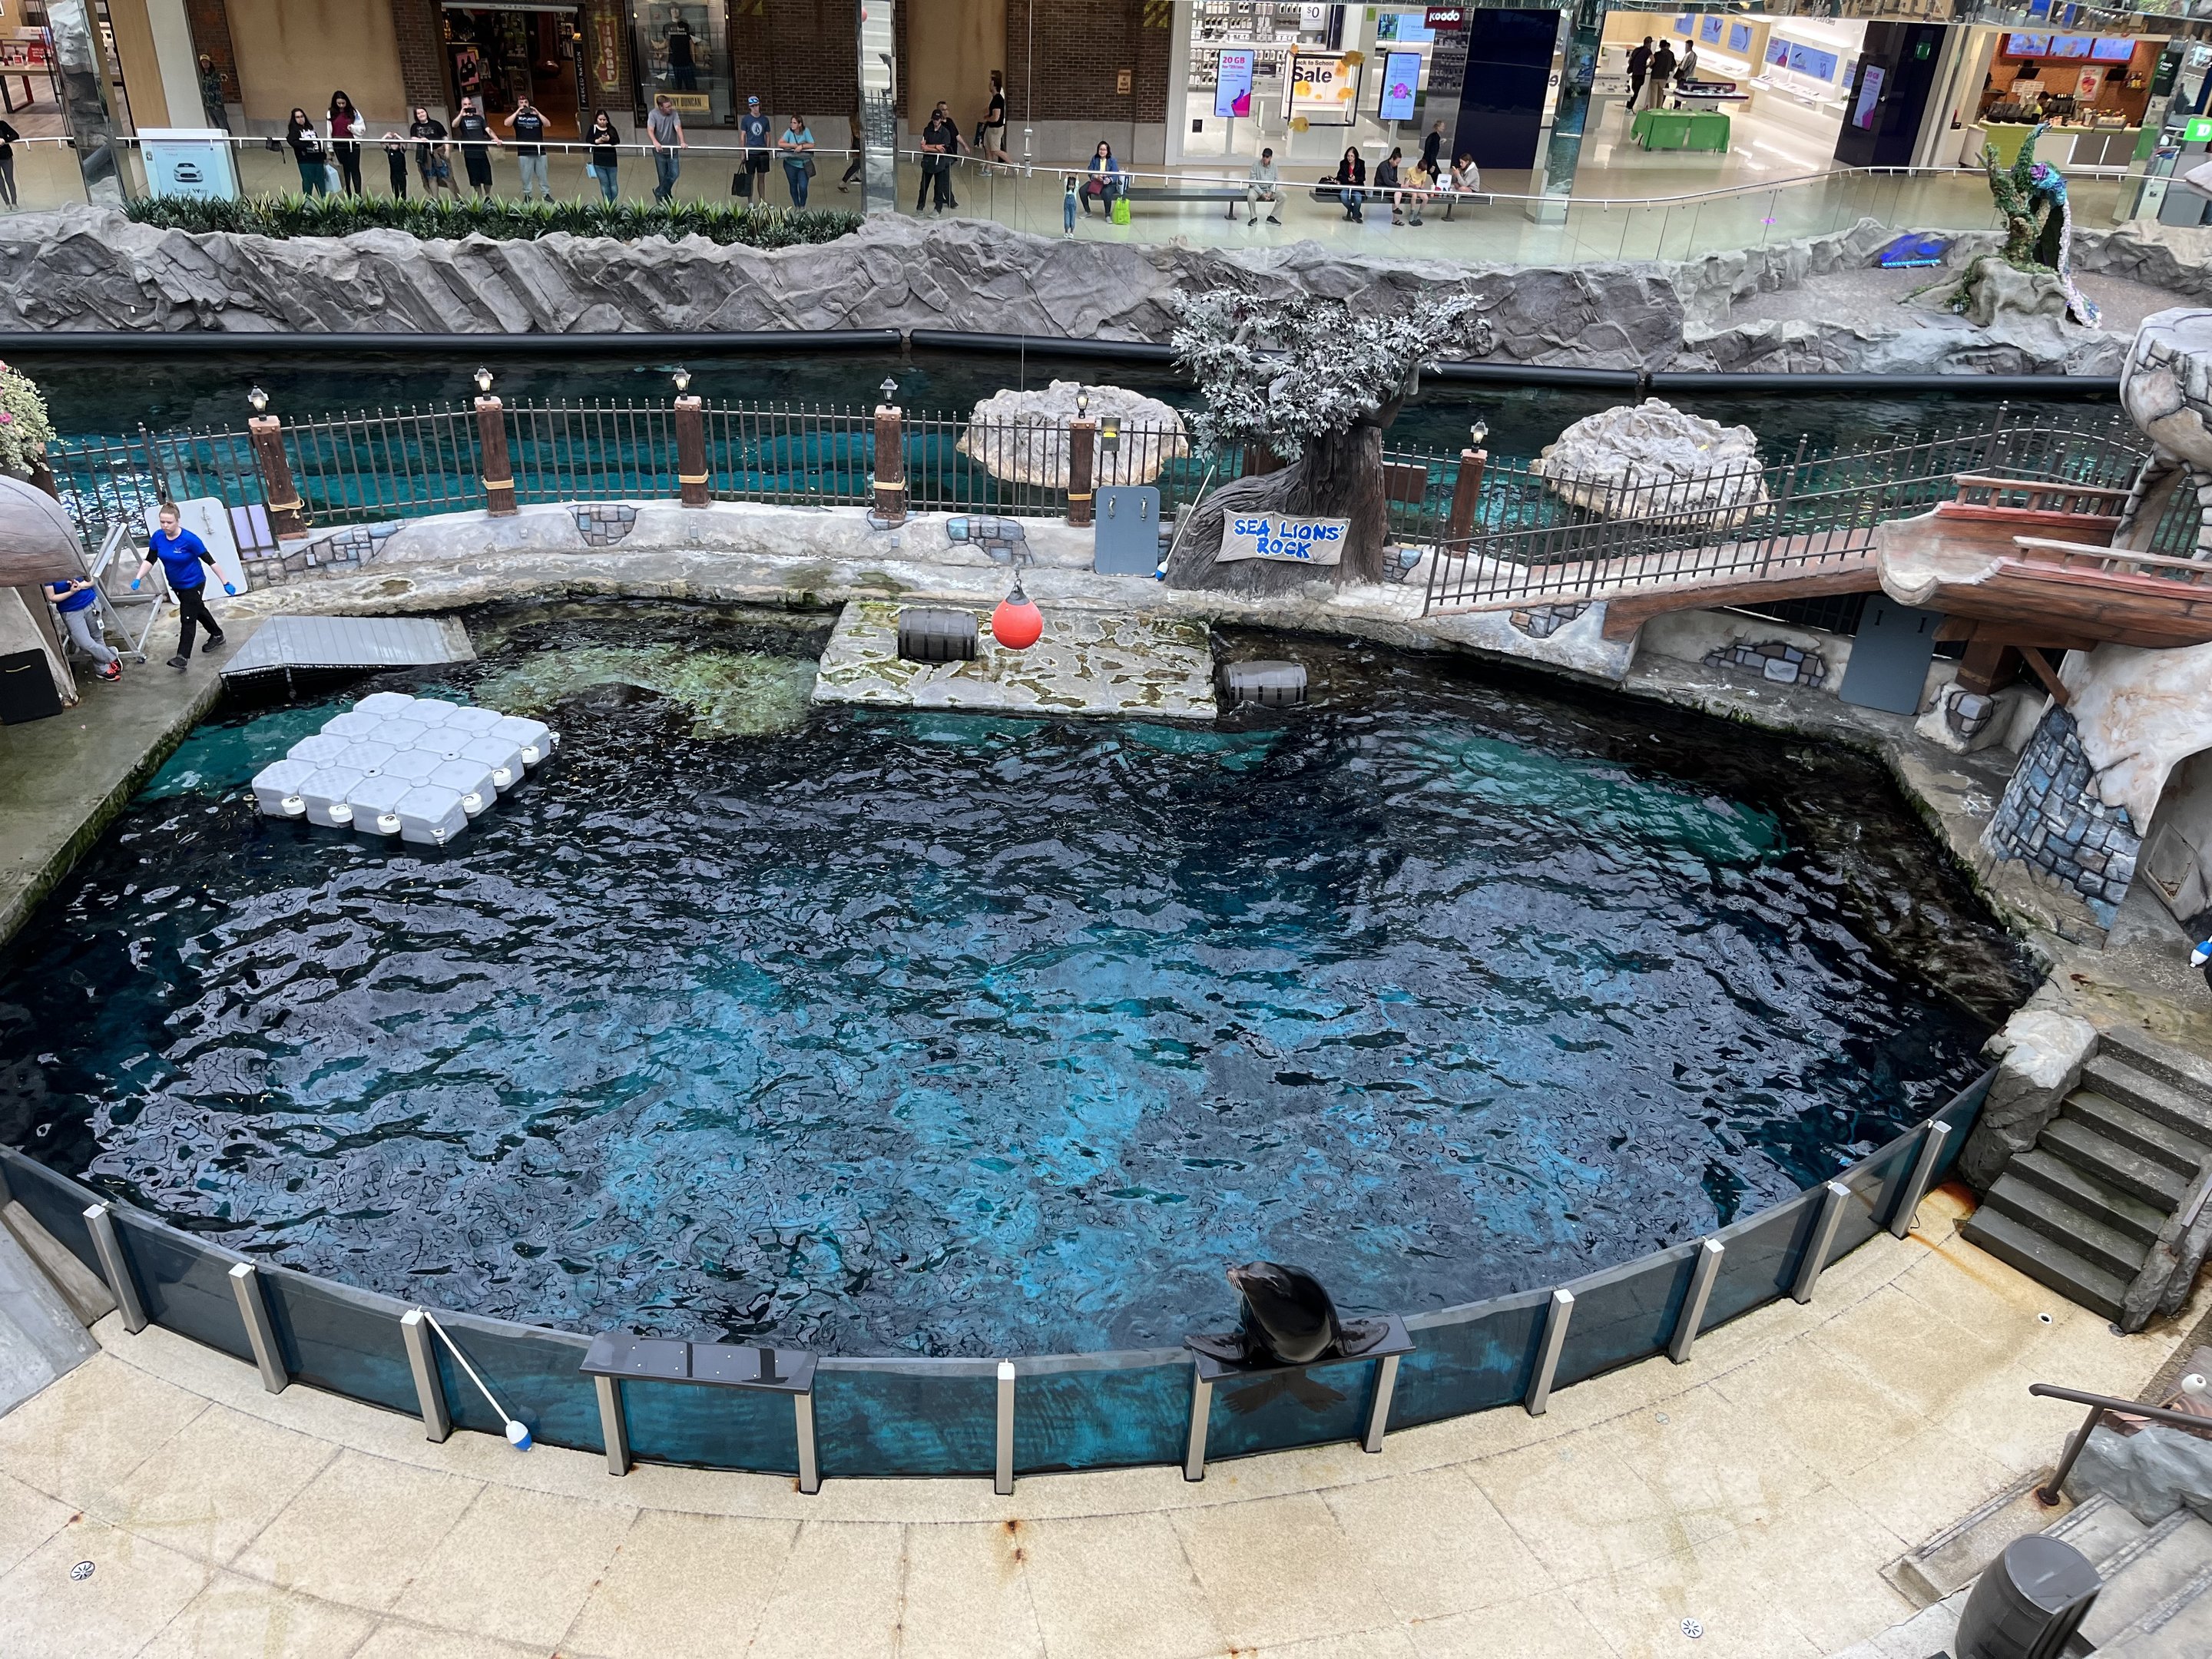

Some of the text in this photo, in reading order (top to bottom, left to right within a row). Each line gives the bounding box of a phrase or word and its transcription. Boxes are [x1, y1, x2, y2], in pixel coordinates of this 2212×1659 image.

[1306, 6, 1320, 18] $0
[1293, 66, 1333, 83] Sale
[680, 98, 702, 107] DUNCAN
[2197, 124, 2210, 136] TD
[1233, 519, 1346, 541] SEA LIONS'
[1255, 537, 1312, 559] ROCK
